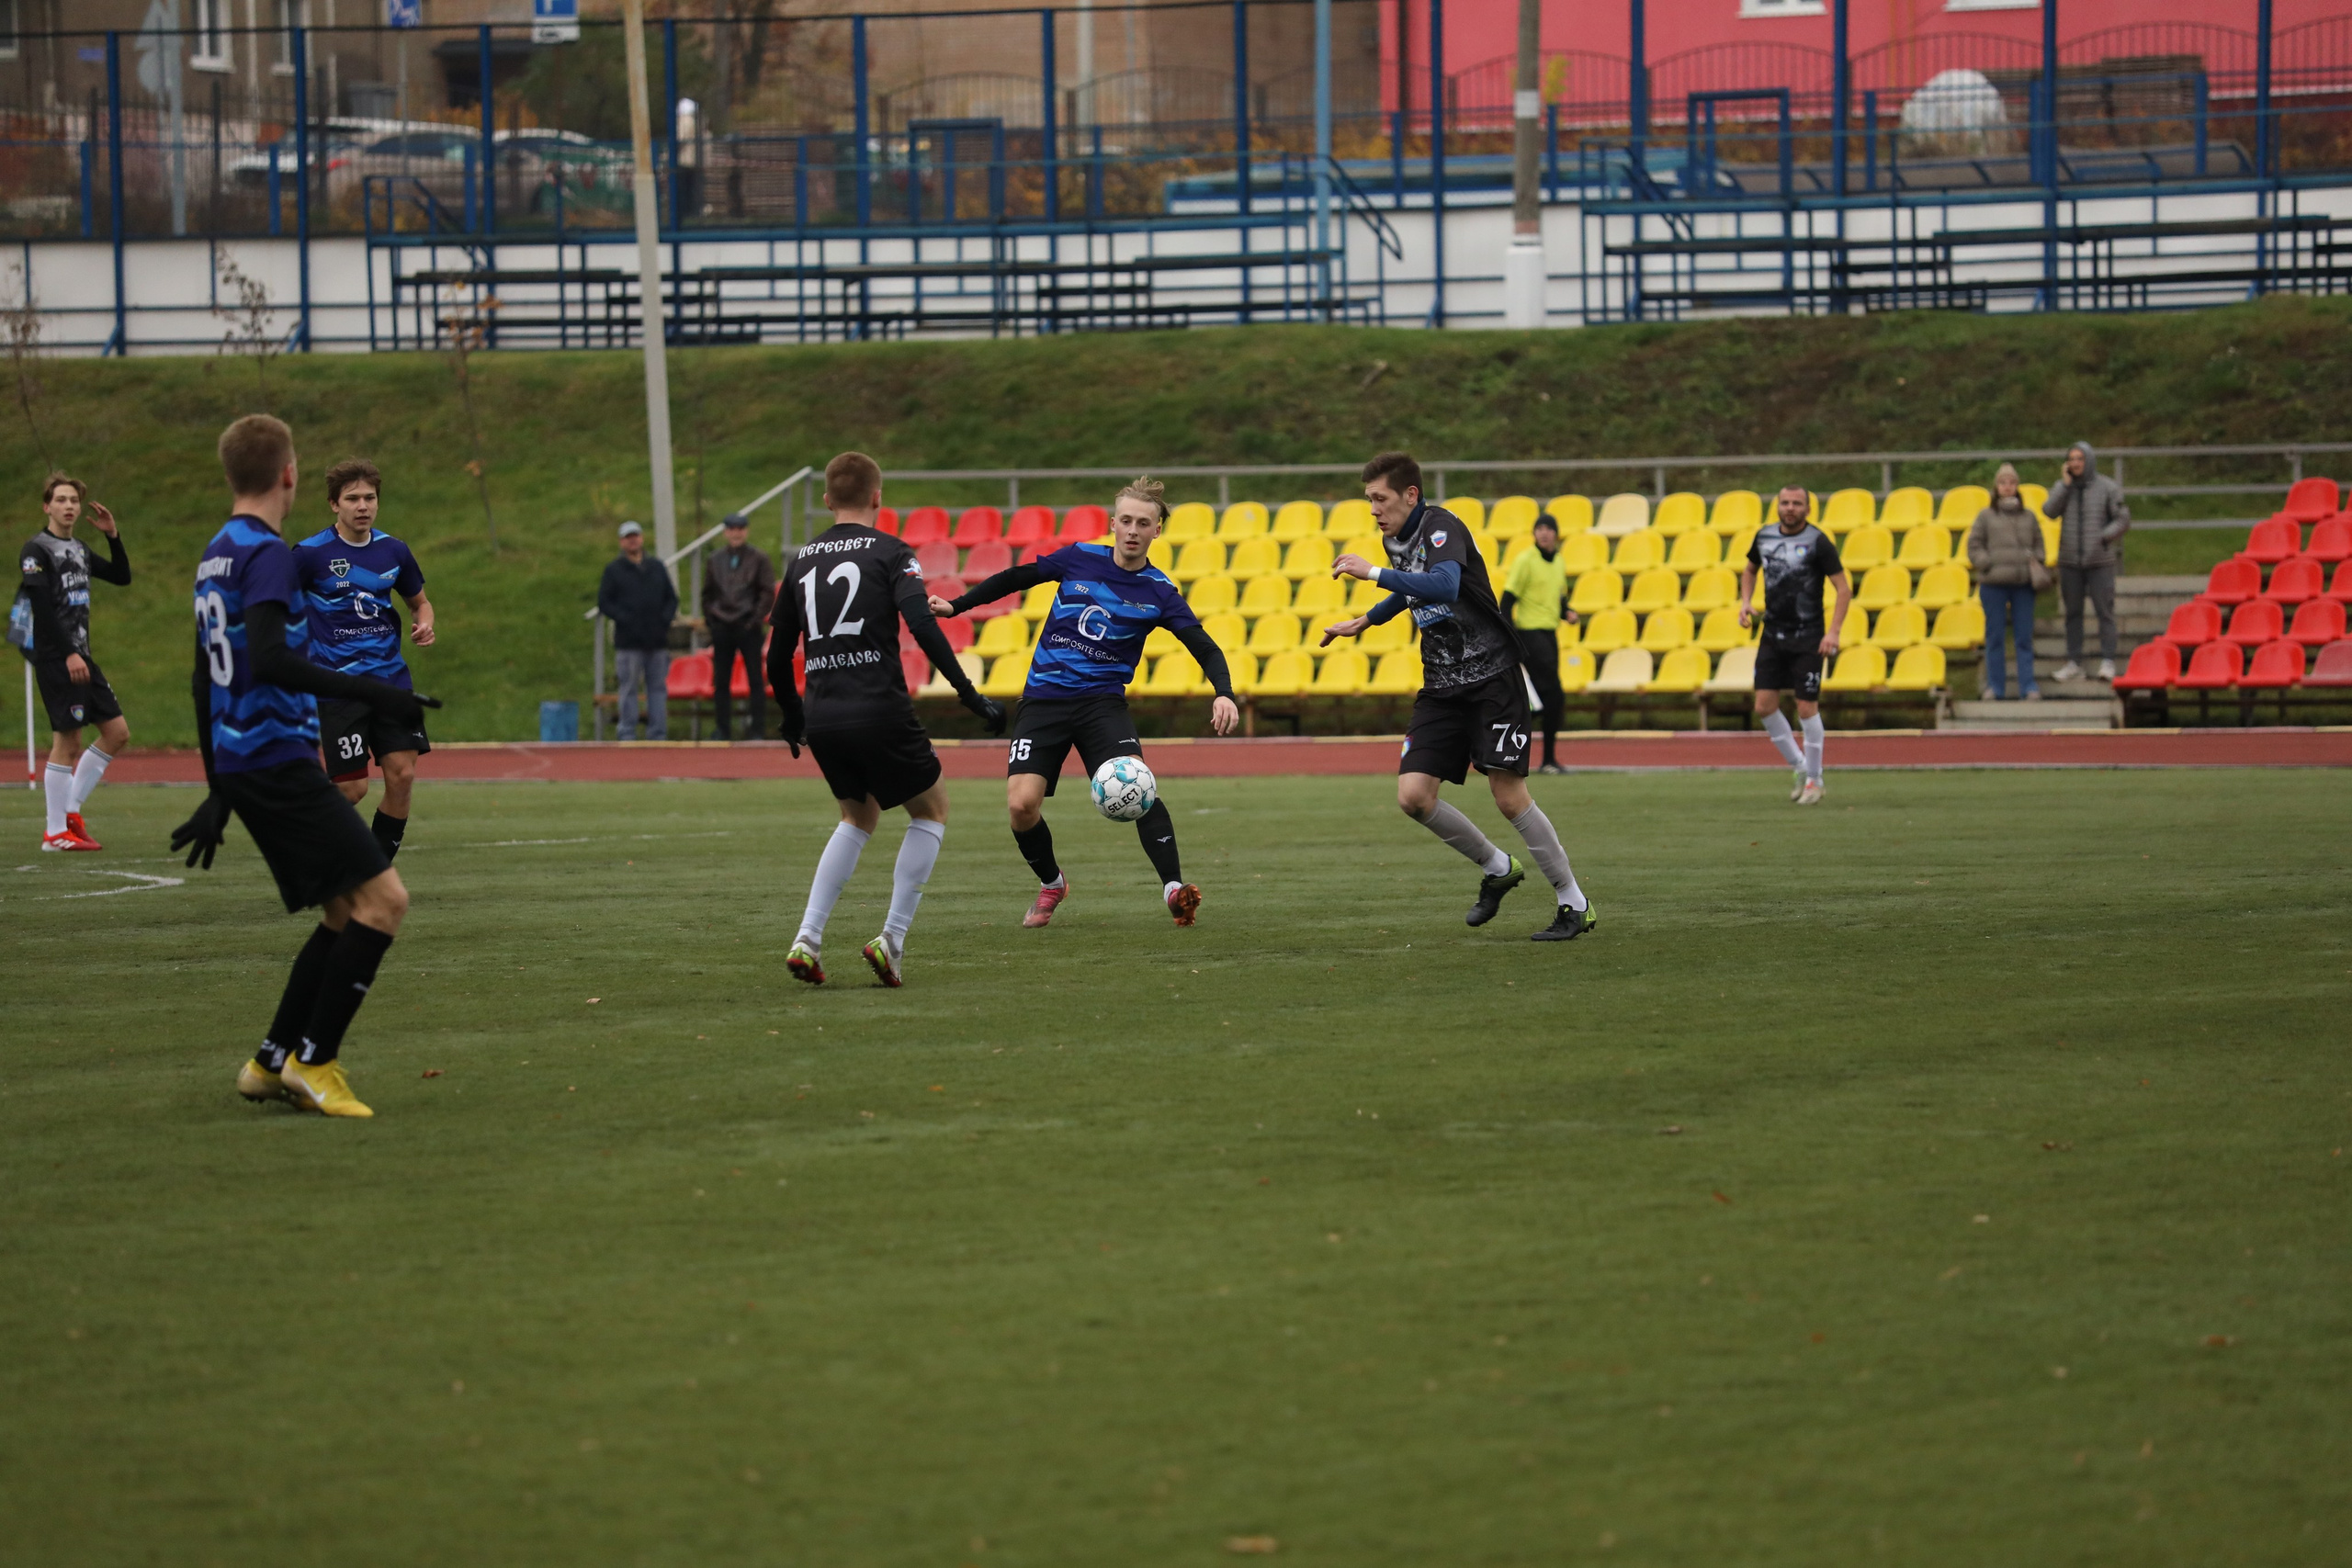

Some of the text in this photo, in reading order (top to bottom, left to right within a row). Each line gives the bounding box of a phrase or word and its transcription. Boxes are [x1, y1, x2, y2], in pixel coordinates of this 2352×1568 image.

[797, 536, 876, 559] ПЕРЕСВЕТ
[1074, 583, 1090, 594] 2022
[798, 561, 865, 642] 12
[334, 626, 378, 636] COMPOSITE
[1051, 633, 1094, 655] COMPOSITE
[337, 733, 364, 760] 32
[1492, 723, 1528, 752] 76
[1107, 788, 1139, 814] SELECT
